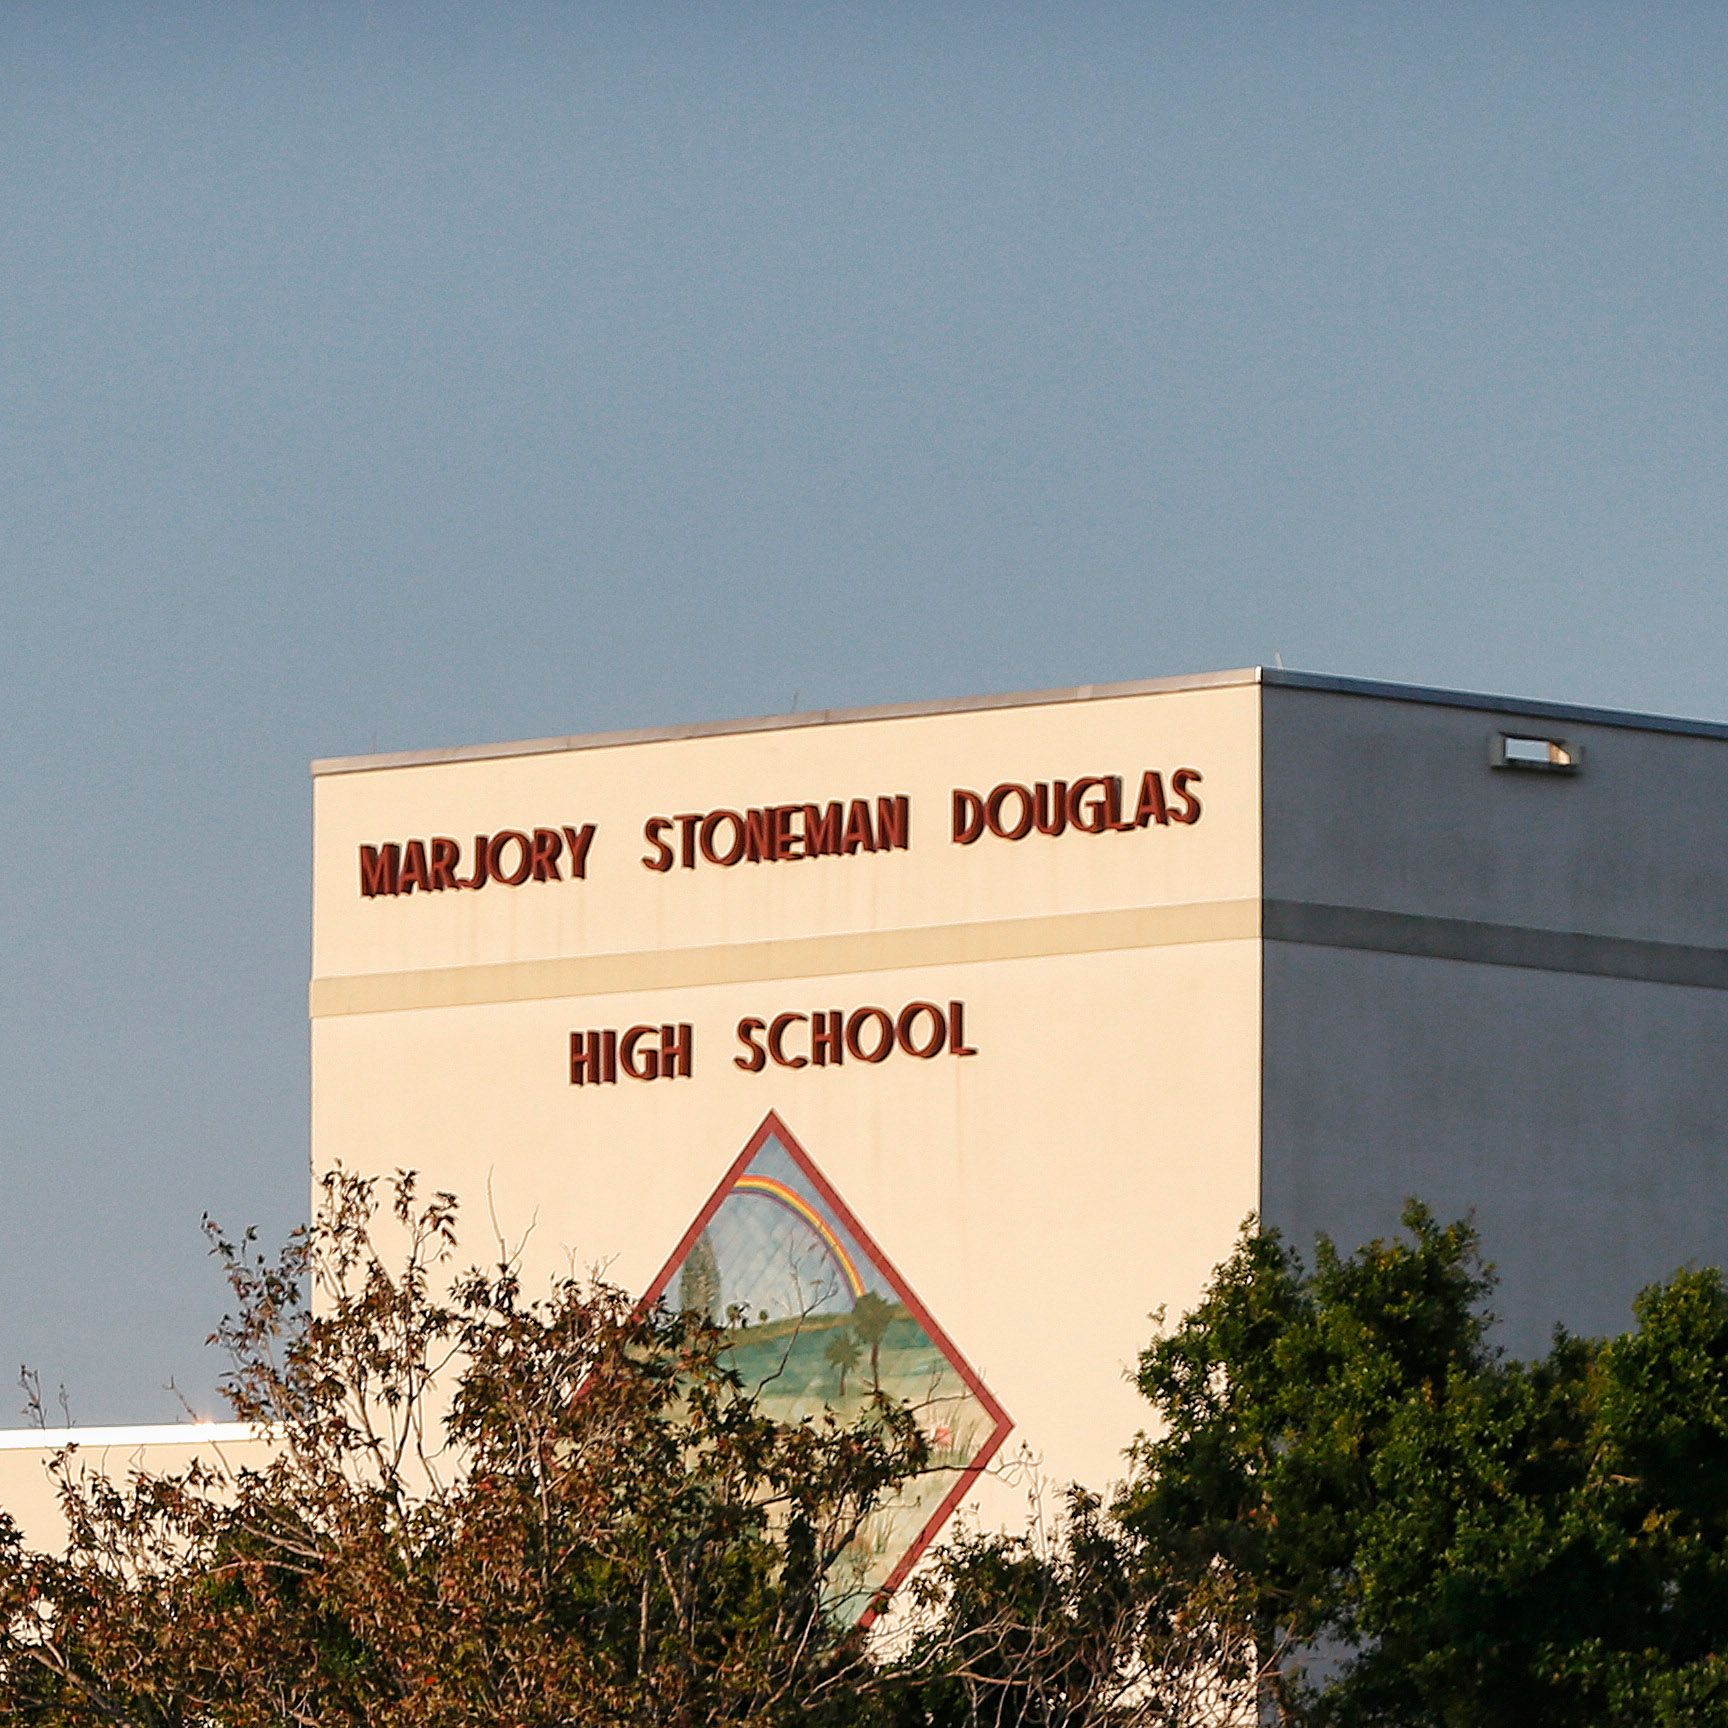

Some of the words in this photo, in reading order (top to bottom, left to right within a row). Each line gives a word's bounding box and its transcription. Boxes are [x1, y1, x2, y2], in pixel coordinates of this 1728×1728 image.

[359, 822, 597, 898] MARJORY
[641, 793, 909, 872] STONEMAN
[952, 767, 1202, 846] DOUGLAS
[569, 1022, 693, 1086] HIGH
[734, 1001, 977, 1073] SCHOOL
